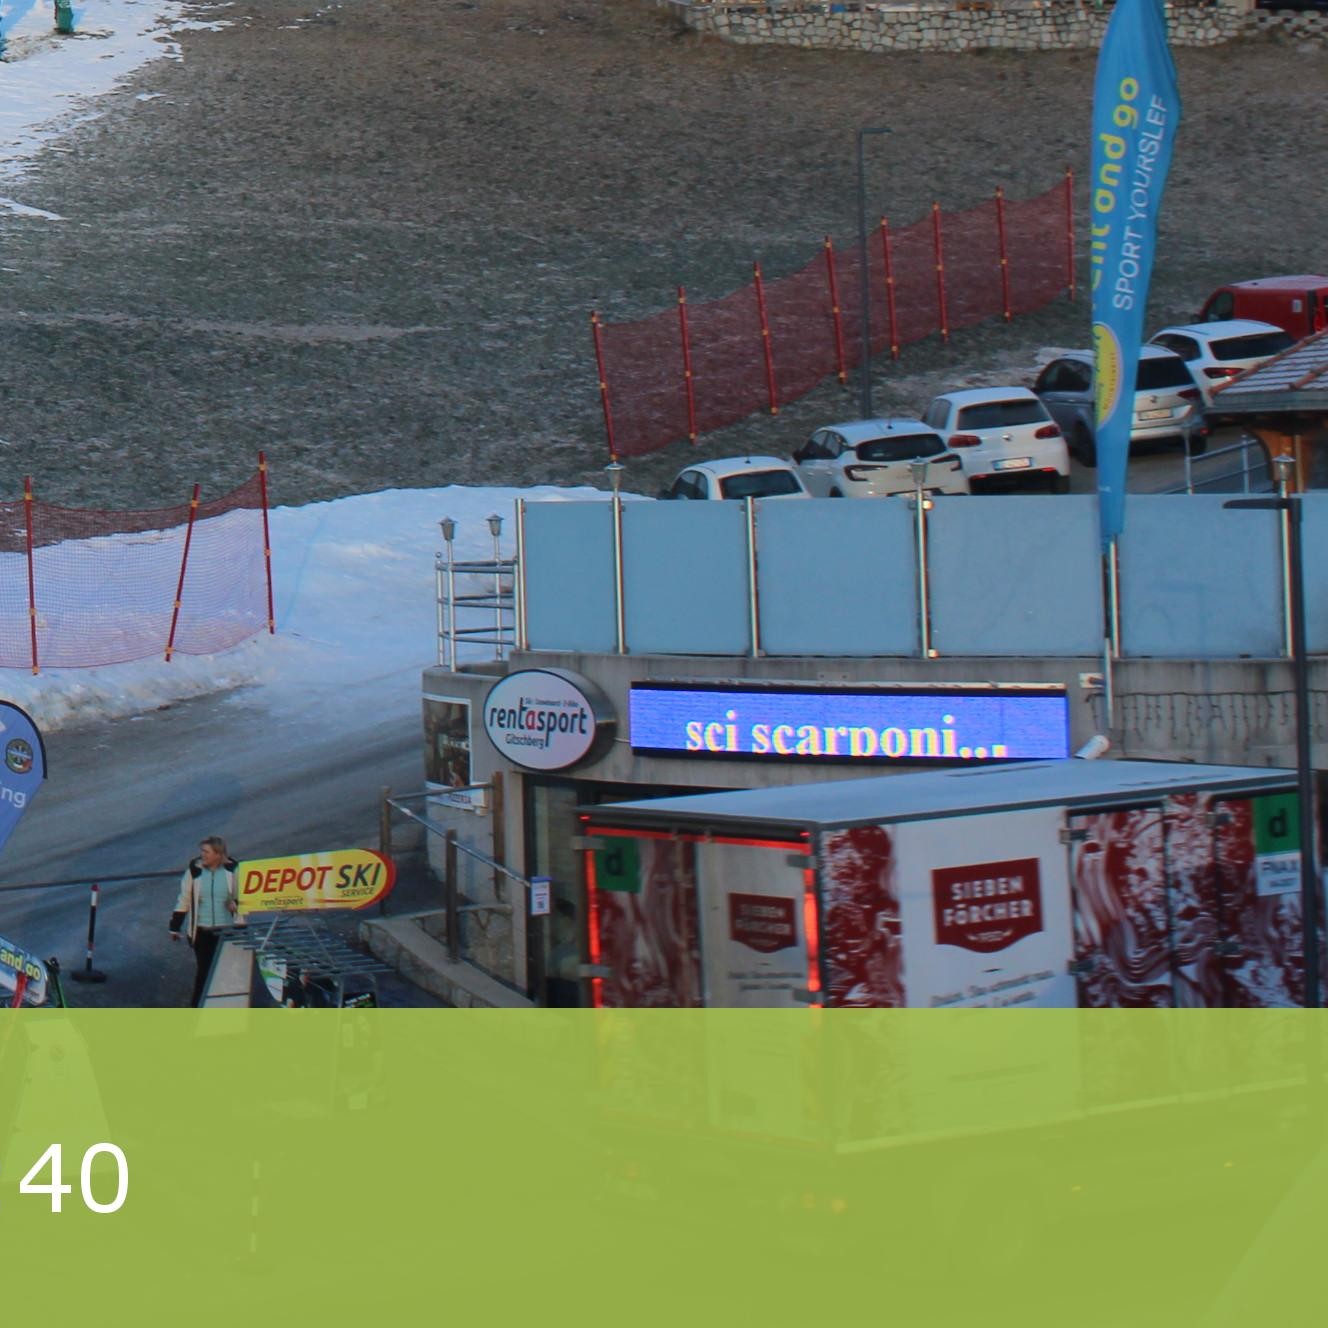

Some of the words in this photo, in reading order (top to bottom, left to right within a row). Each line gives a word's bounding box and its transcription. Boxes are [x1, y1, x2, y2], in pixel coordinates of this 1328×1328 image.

[1112, 77, 1139, 129] go
[1112, 226, 1142, 311] SPORT
[489, 697, 587, 747] rentasport
[685, 710, 738, 752] sci
[243, 866, 333, 894] DEPOT
[335, 863, 382, 889] SKI
[951, 876, 1024, 902] SIEBEN
[0, 948, 23, 971] and
